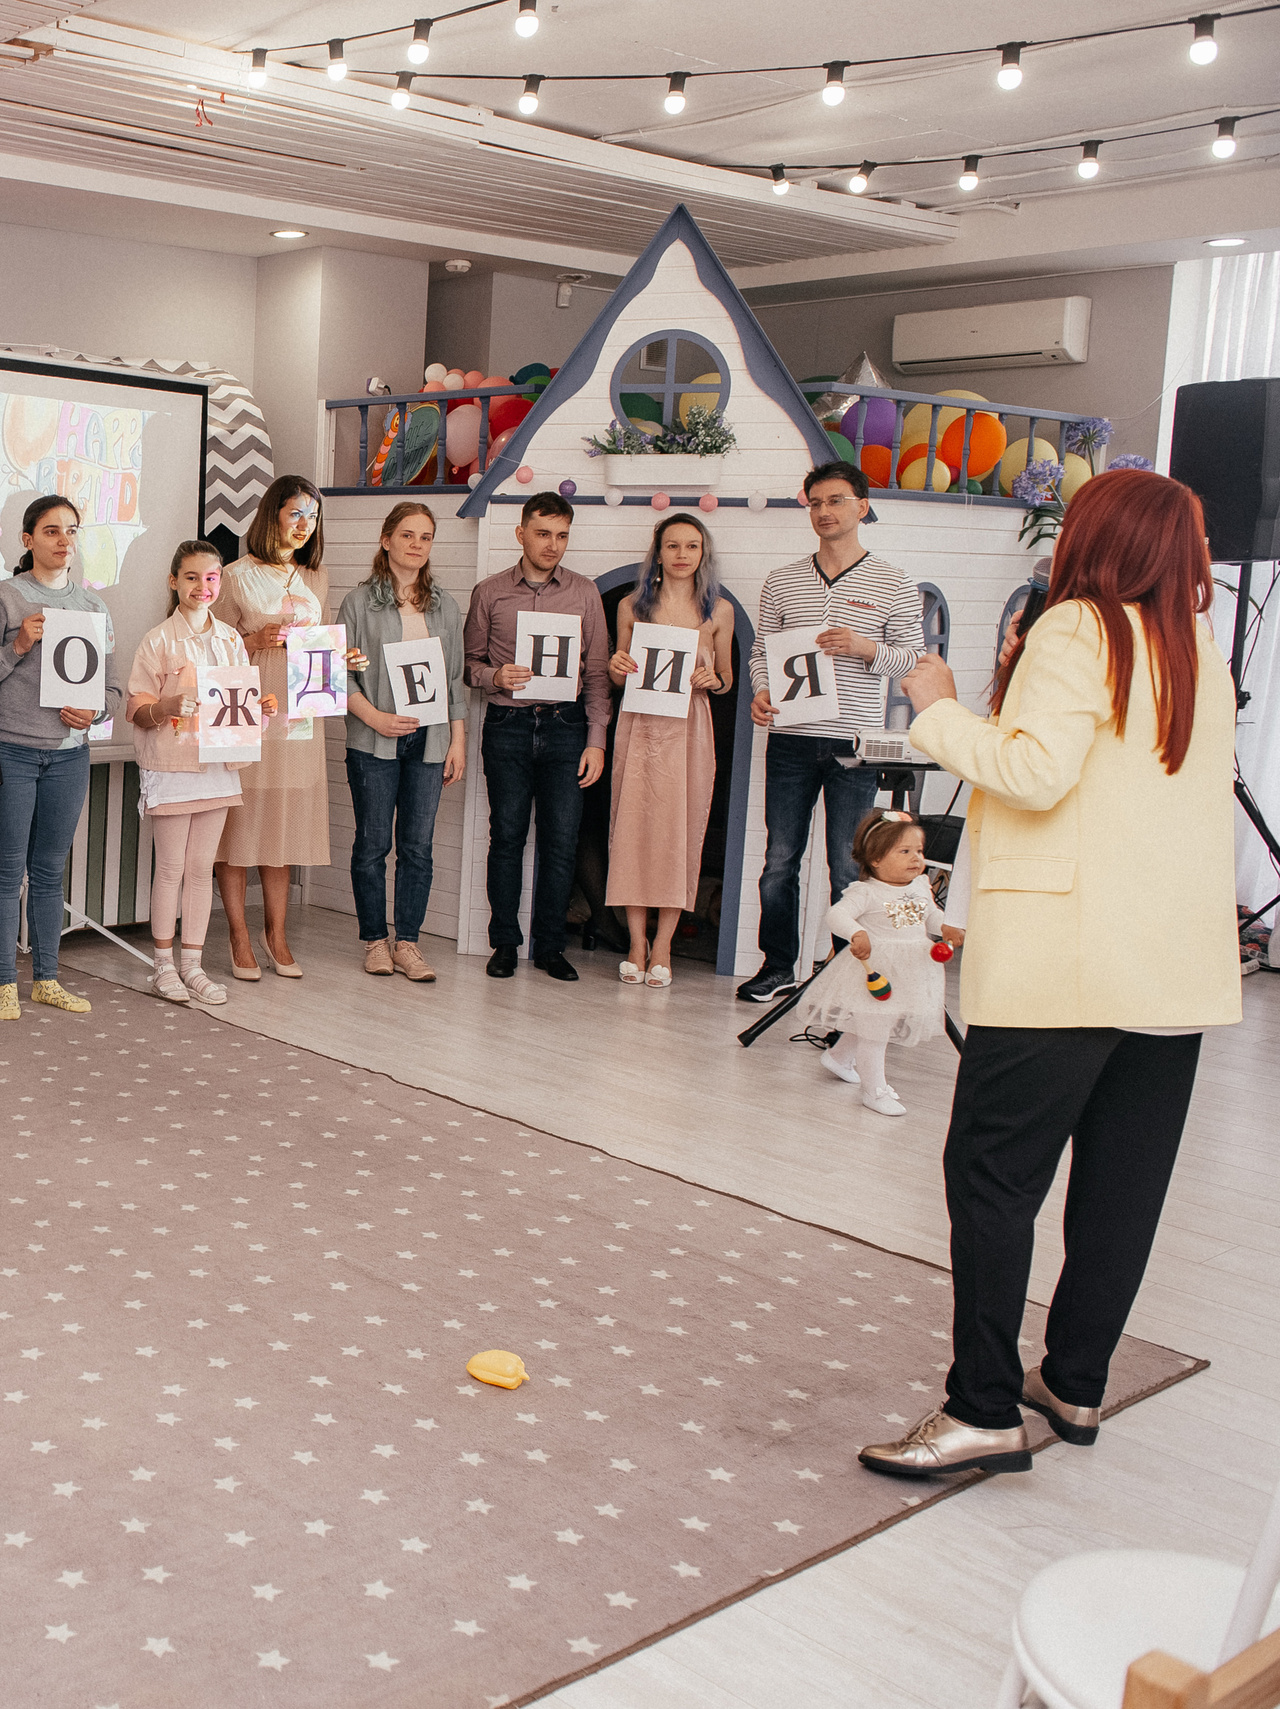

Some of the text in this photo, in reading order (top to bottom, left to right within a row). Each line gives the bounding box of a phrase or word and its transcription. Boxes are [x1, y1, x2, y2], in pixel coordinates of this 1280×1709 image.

[52, 635, 99, 685] О
[296, 650, 337, 707] Д
[530, 635, 576, 681] Н
[639, 646, 691, 695] И
[779, 651, 827, 703] Я
[208, 687, 259, 727] Ж
[402, 662, 437, 707] Е
